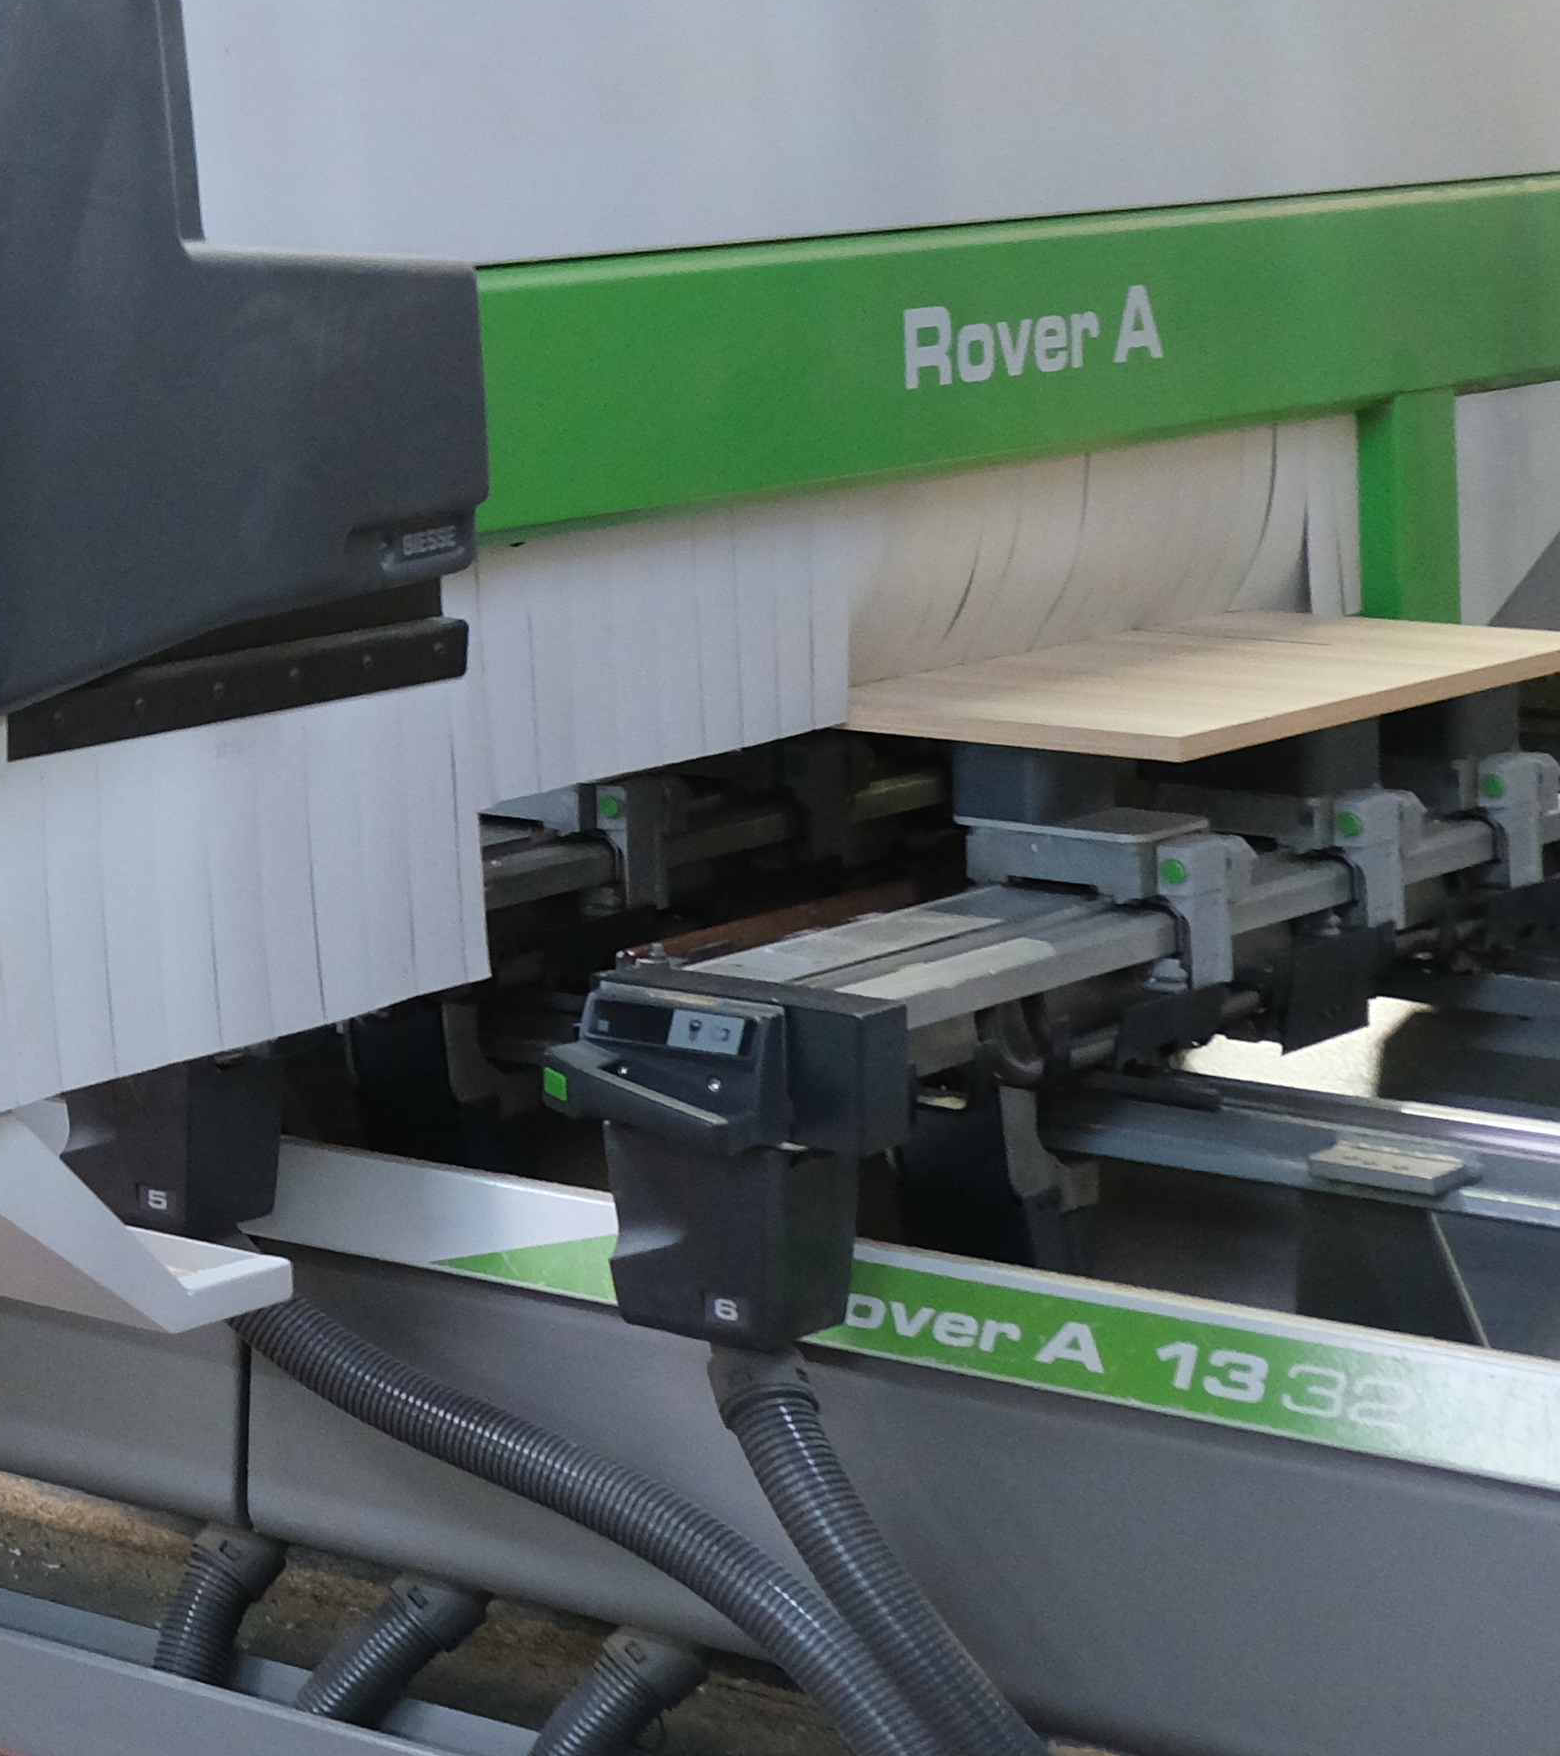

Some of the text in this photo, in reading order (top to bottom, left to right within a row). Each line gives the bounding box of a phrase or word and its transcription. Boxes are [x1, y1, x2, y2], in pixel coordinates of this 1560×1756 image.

[903, 284, 1164, 390] Rover A
[402, 525, 456, 556] BIESSE
[148, 1189, 168, 1211] 5
[714, 1298, 739, 1322] 6
[844, 1293, 1023, 1354] over
[1033, 1321, 1105, 1374] A
